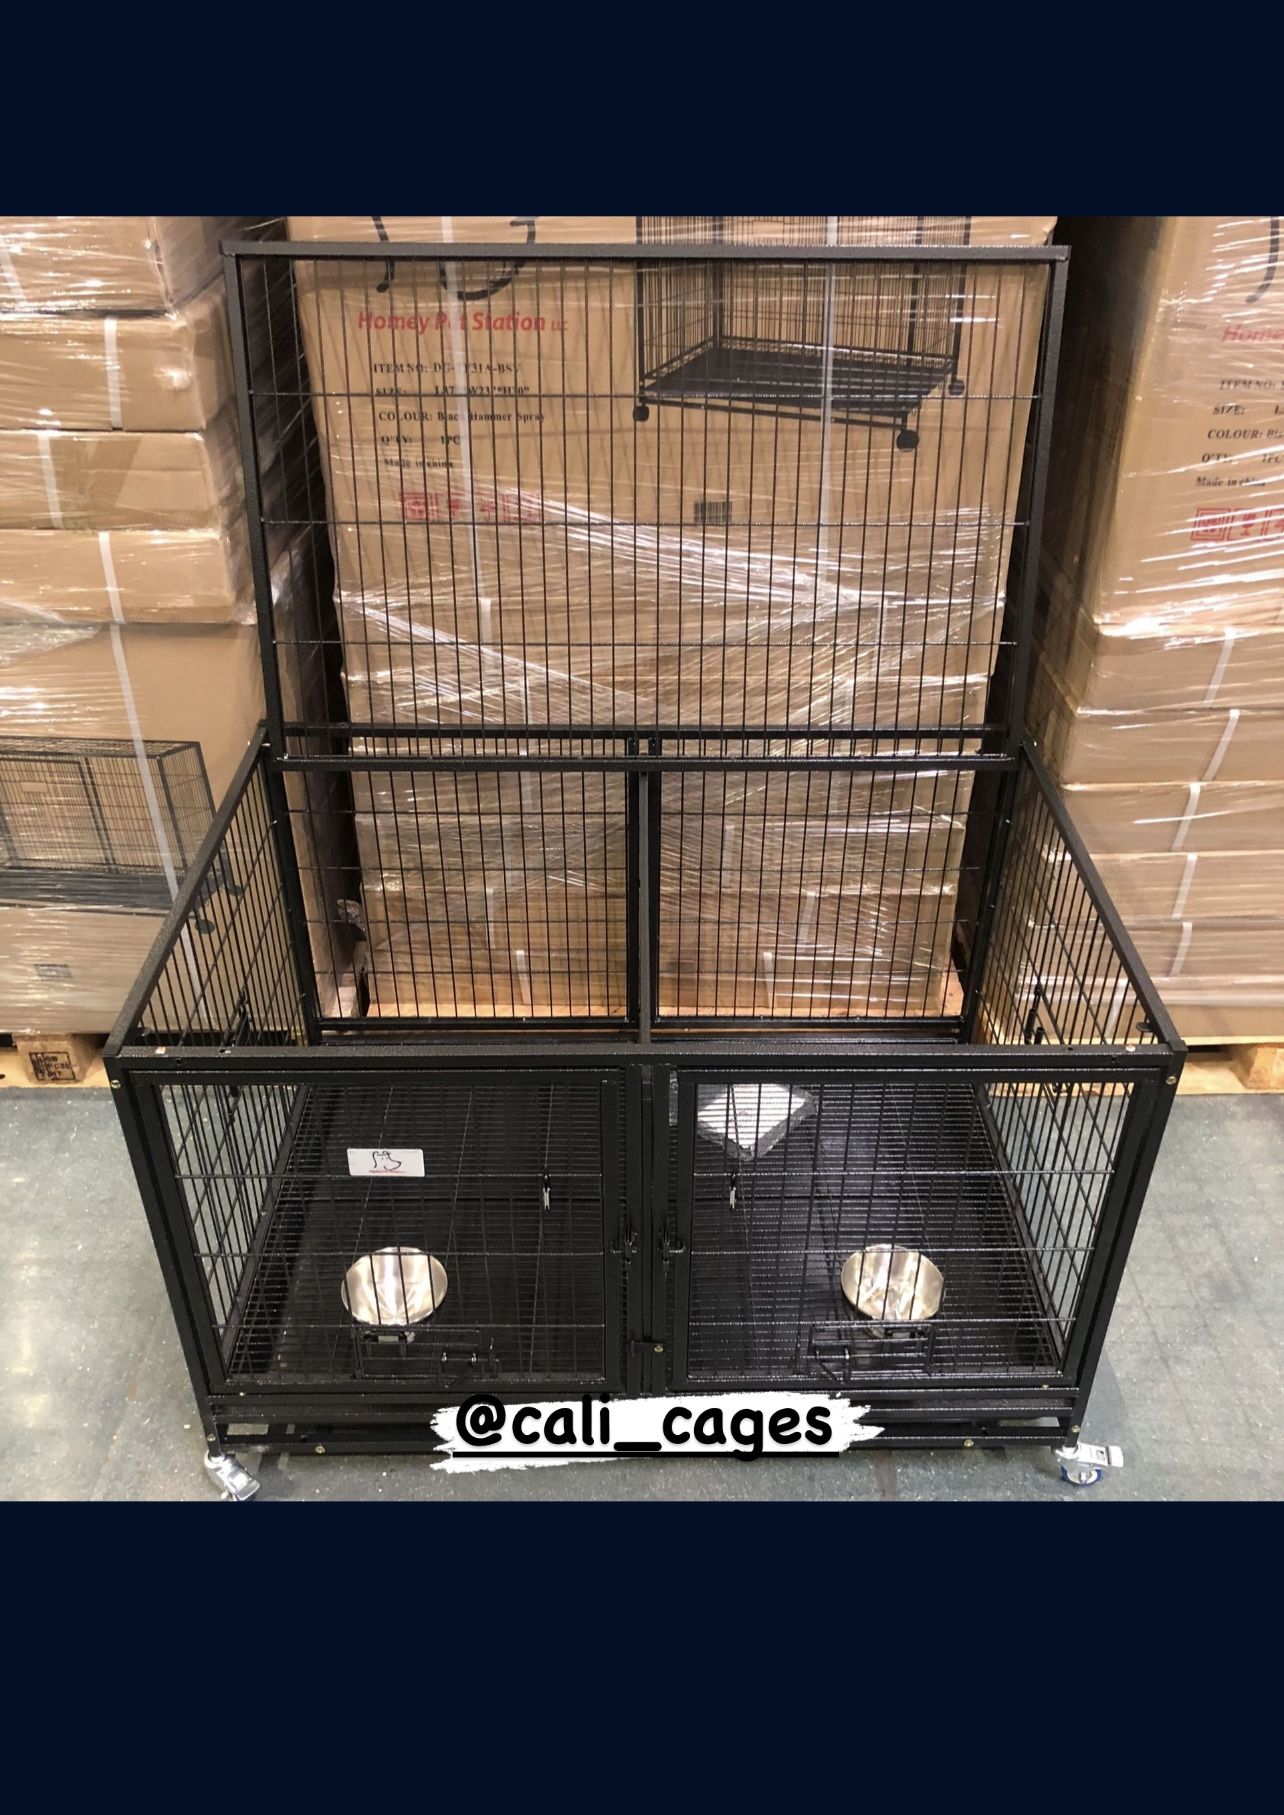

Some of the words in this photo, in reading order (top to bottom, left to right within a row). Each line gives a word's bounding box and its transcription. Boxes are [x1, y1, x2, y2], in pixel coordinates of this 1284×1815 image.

[358, 311, 430, 335] Homey
[435, 312, 468, 331] Pt
[472, 311, 546, 331] Station
[1213, 404, 1246, 415] SIZE:
[379, 411, 433, 422] COLOUR:
[1207, 428, 1262, 439] COLOUR:
[1195, 477, 1223, 487] Made
